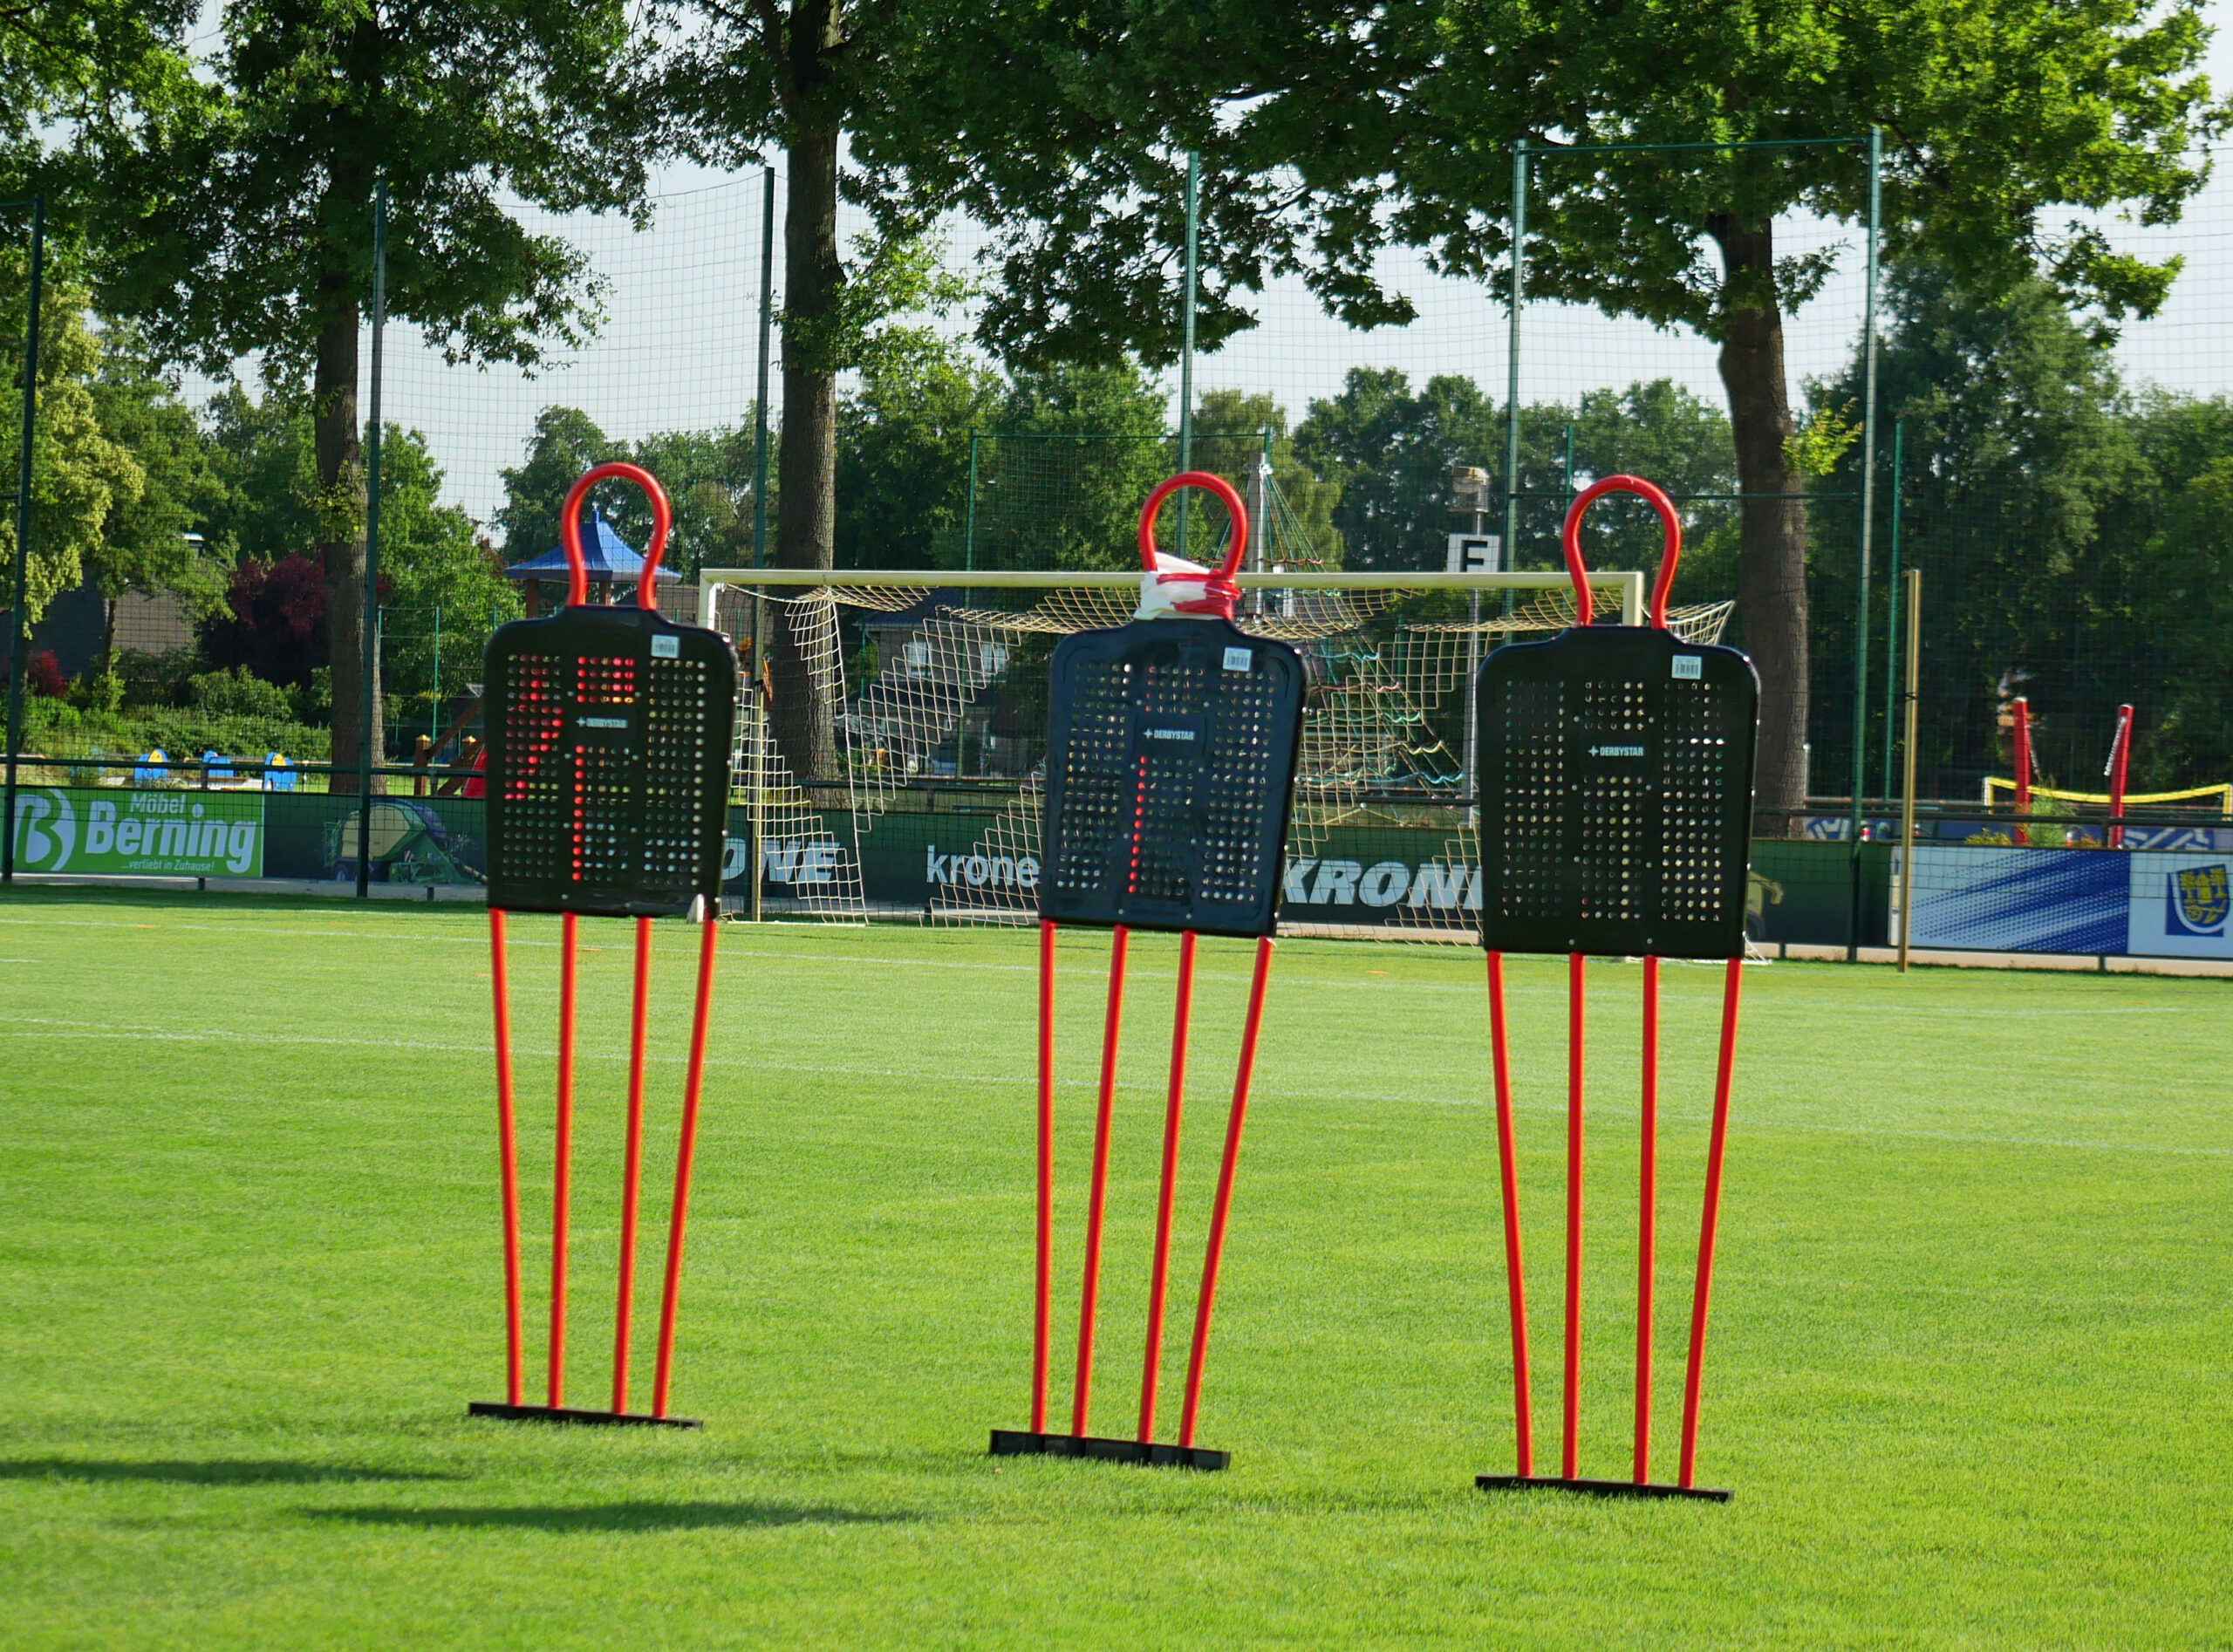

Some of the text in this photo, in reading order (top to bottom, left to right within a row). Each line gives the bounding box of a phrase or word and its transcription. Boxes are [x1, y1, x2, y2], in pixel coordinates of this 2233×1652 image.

[1154, 729, 1194, 741] DERBYSTAR
[1600, 746, 1643, 756] DERBYSTAR
[130, 792, 187, 814] Möbel
[85, 800, 256, 873] Berning
[165, 859, 173, 870] in
[174, 859, 215, 871] Zuhause!
[926, 844, 1040, 887] krone
